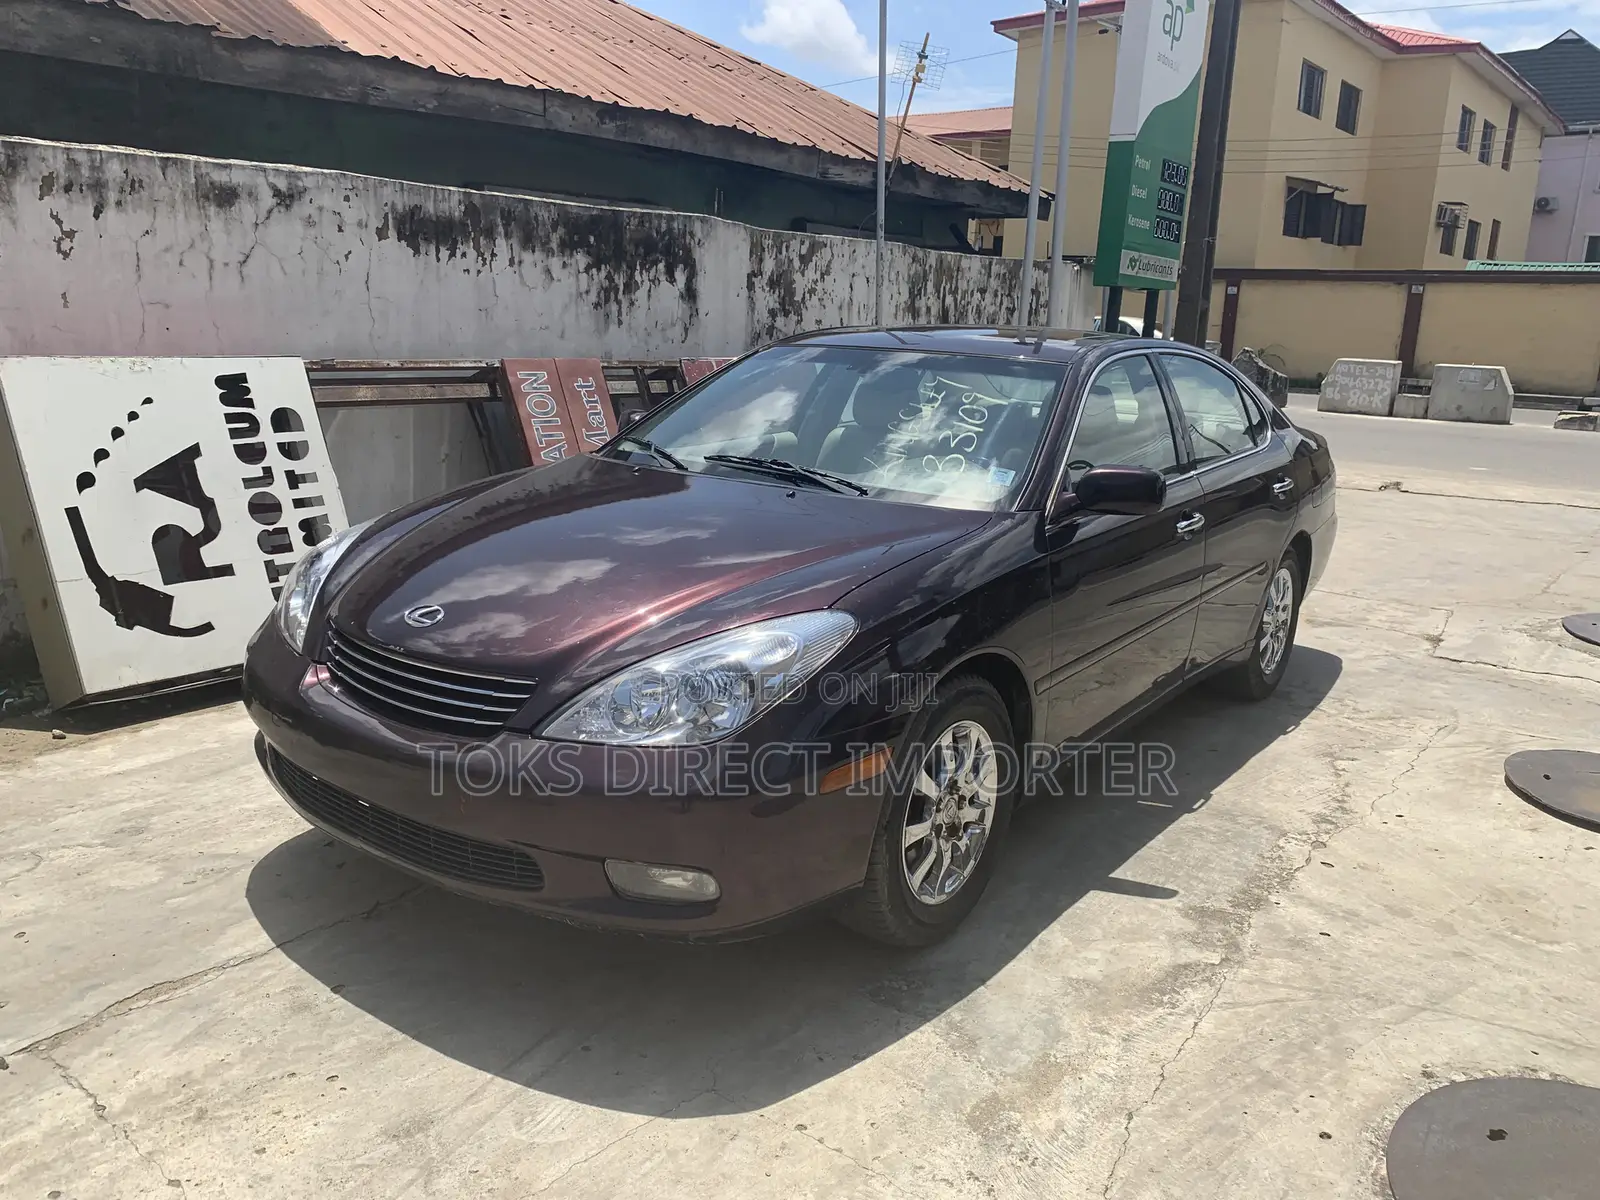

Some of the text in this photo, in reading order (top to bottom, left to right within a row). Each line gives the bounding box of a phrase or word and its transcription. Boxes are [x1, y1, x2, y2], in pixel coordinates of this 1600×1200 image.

[1135, 154, 1151, 171] Petrol
[1131, 183, 1148, 199] Diesel
[1127, 213, 1151, 230] Kerosene
[1138, 258, 1173, 276] Lubricants
[922, 392, 1009, 473] 33109
[214, 371, 297, 603] TROLEUM
[133, 441, 236, 586] RA
